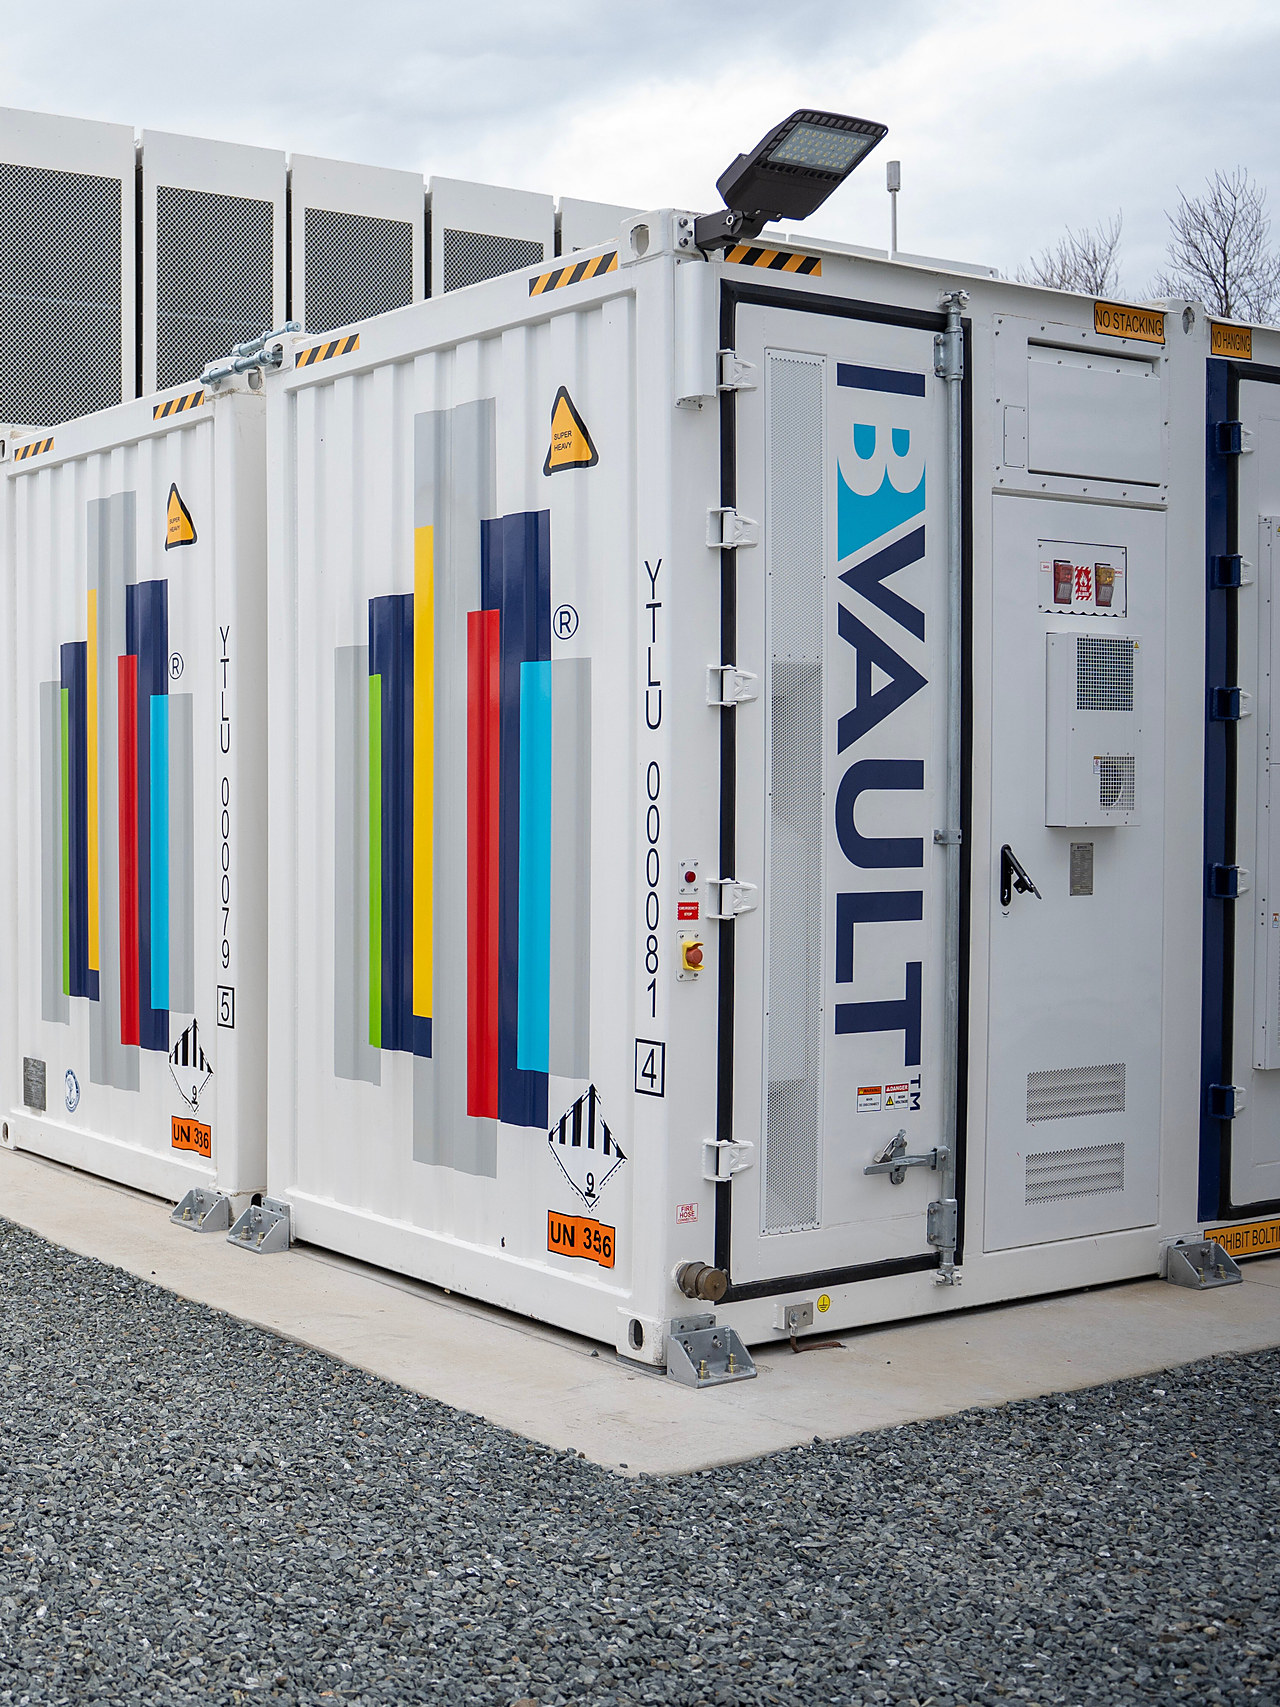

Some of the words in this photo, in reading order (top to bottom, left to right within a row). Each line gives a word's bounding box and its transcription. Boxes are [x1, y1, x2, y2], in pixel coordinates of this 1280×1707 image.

[1095, 310, 1111, 329] NO
[1113, 312, 1163, 337] STACKING
[1212, 331, 1222, 349] NO
[1223, 333, 1250, 352] HANGING
[553, 430, 572, 441] SUPER
[553, 441, 572, 452] HEAVY
[644, 559, 662, 730] YTLU
[220, 625, 230, 754] YTLU
[220, 776, 230, 970] 000079
[645, 761, 661, 1018] 000081
[220, 991, 230, 1023] 5
[640, 1048, 657, 1088] 4
[191, 1085, 198, 1102] 9
[173, 1123, 191, 1143] UN
[586, 1172, 595, 1194] 9
[680, 1210, 695, 1218] HOSE
[550, 1220, 575, 1248] UN
[1252, 1226, 1280, 1246] BOLTI
